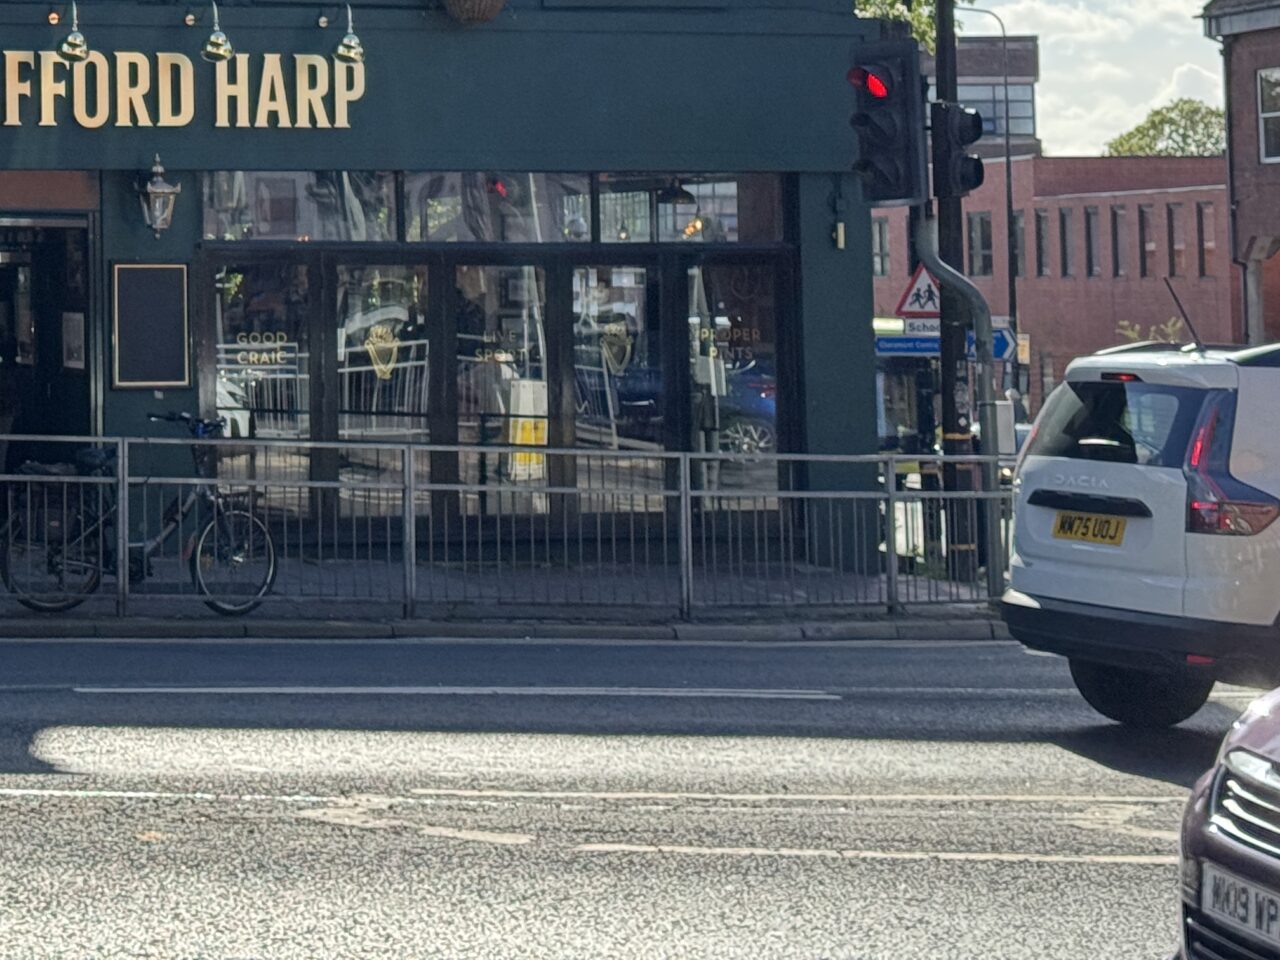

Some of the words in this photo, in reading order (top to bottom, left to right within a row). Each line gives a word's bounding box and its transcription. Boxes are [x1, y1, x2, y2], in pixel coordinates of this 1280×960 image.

[213, 52, 366, 128] HARP
[908, 320, 940, 333] Scho
[236, 332, 288, 345] GOOD
[483, 330, 517, 343] LIVE
[236, 351, 288, 364] CRAIC
[1054, 473, 1110, 489] DACIA
[1255, 892, 1280, 936] WP
